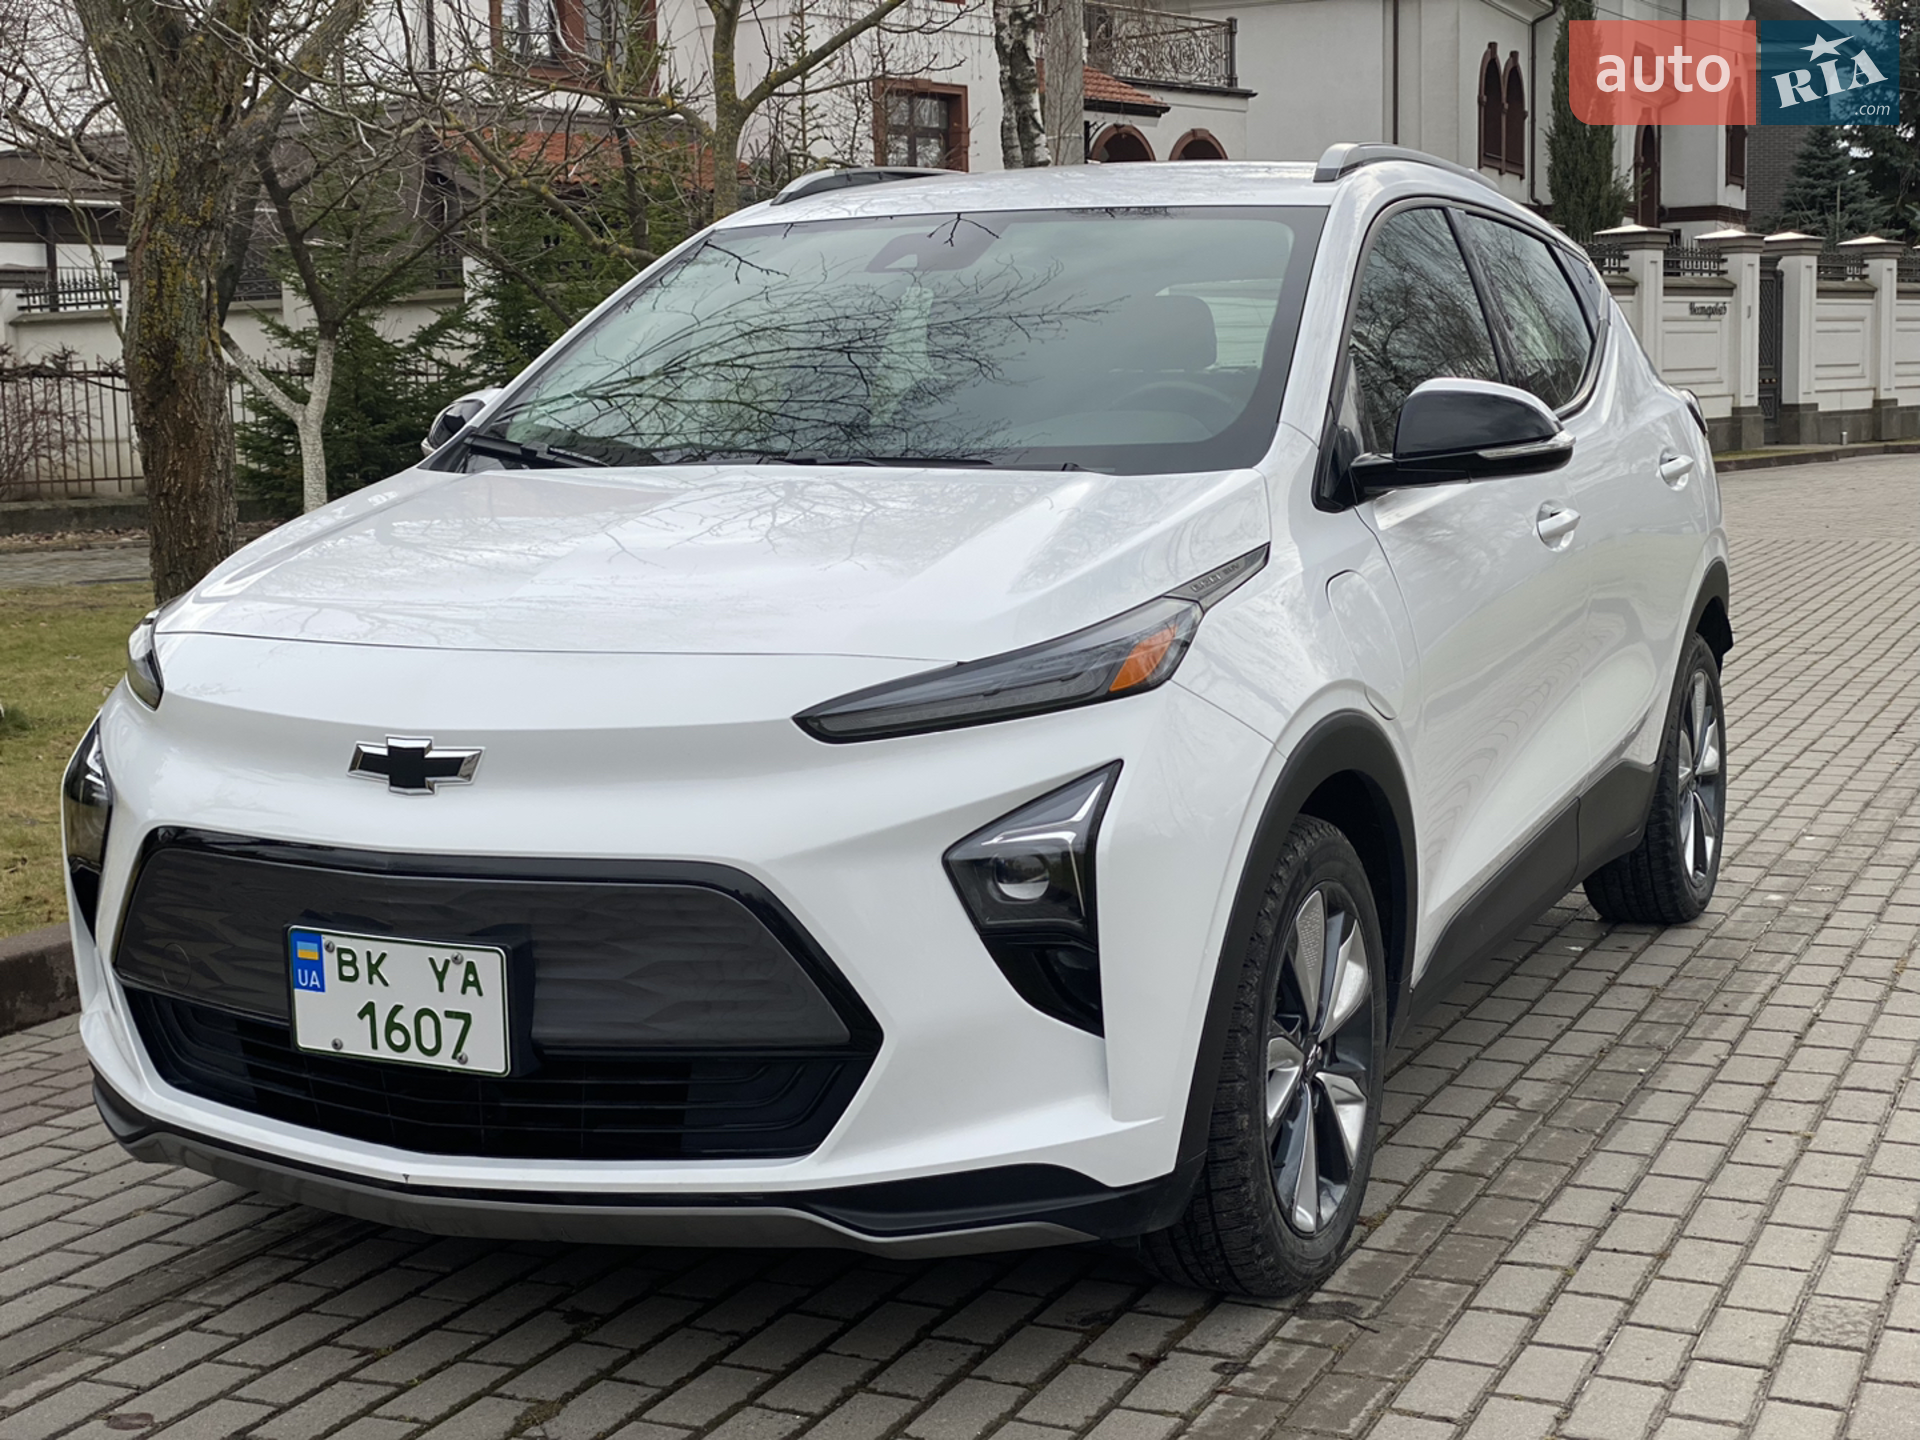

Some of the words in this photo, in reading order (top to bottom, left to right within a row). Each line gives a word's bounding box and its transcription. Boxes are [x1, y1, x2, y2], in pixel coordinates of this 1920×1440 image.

[297, 968, 321, 989] UA
[336, 946, 389, 987] BK
[428, 956, 484, 997] YA
[357, 1001, 473, 1060] 1607
